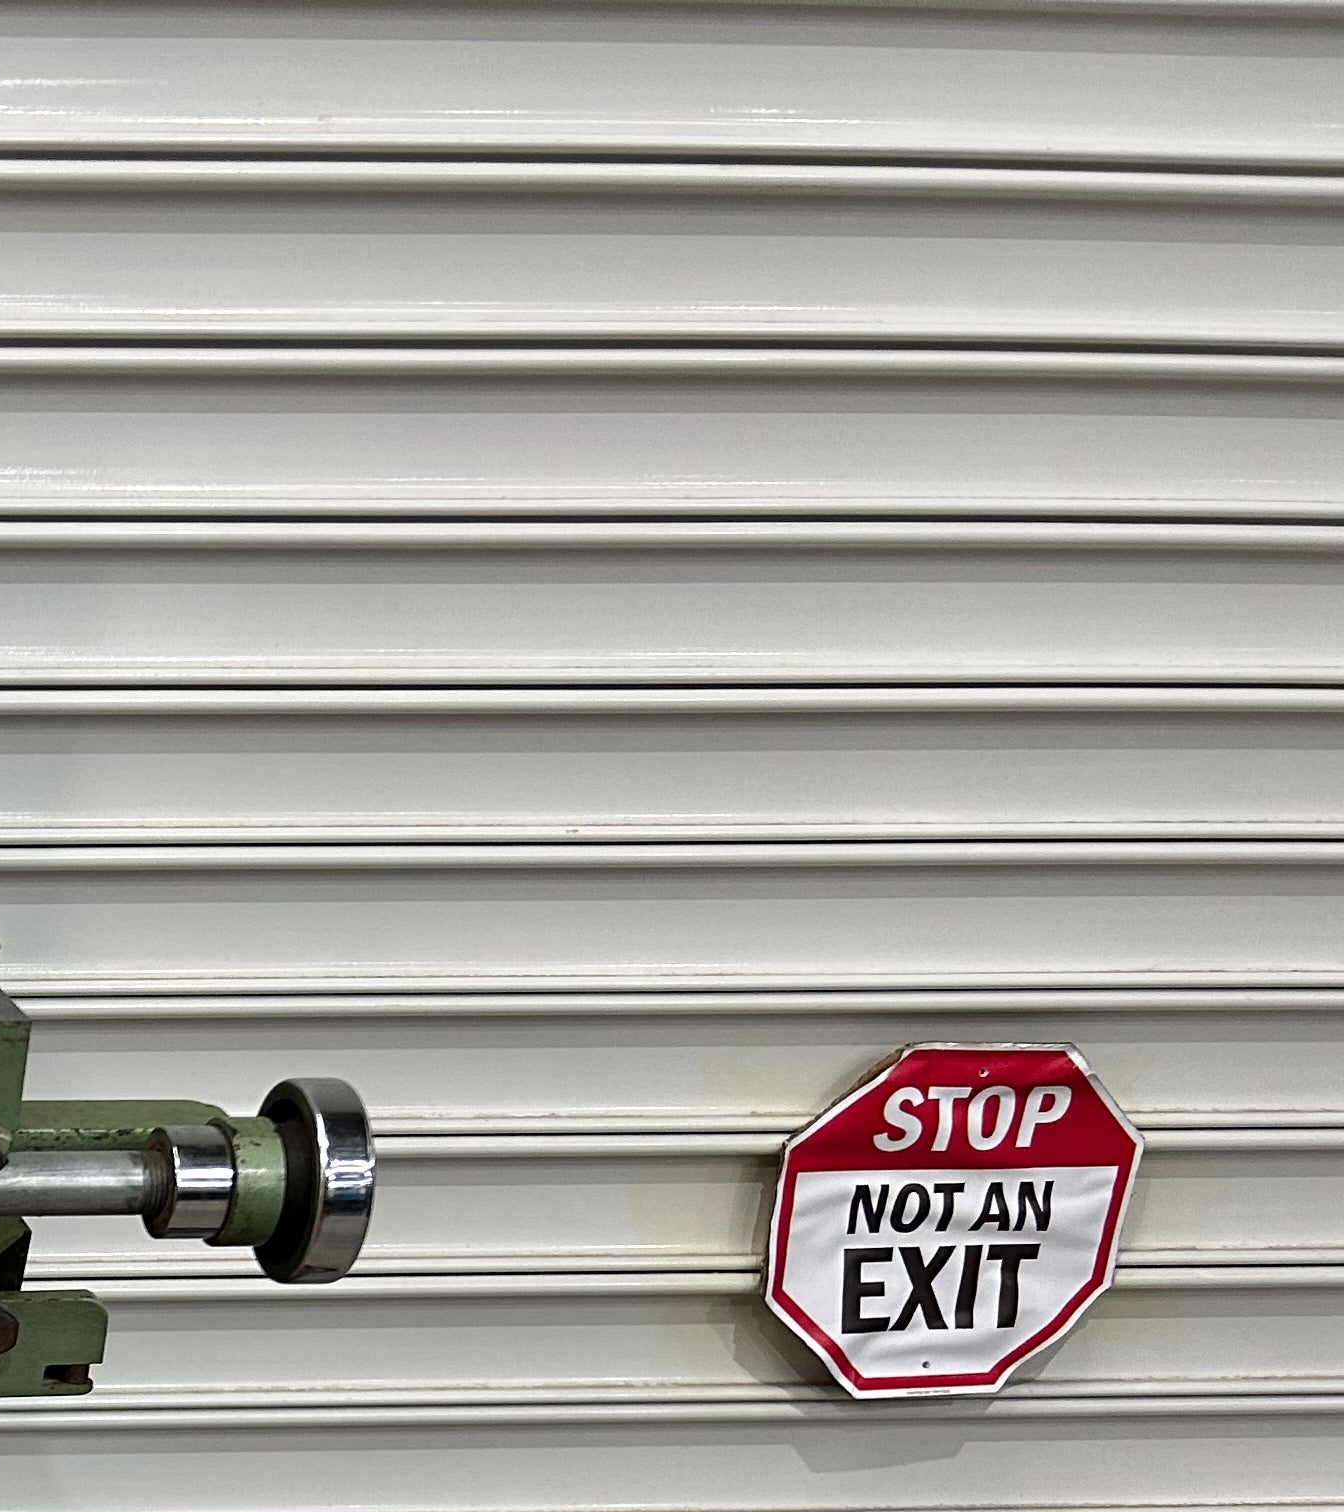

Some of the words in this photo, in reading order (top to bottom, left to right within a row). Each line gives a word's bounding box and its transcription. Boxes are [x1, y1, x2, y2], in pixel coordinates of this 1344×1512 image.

[873, 1085, 1072, 1154] STOP
[846, 1181, 965, 1235] NOT
[968, 1180, 1055, 1232] AN
[841, 1243, 1041, 1335] EXIT
